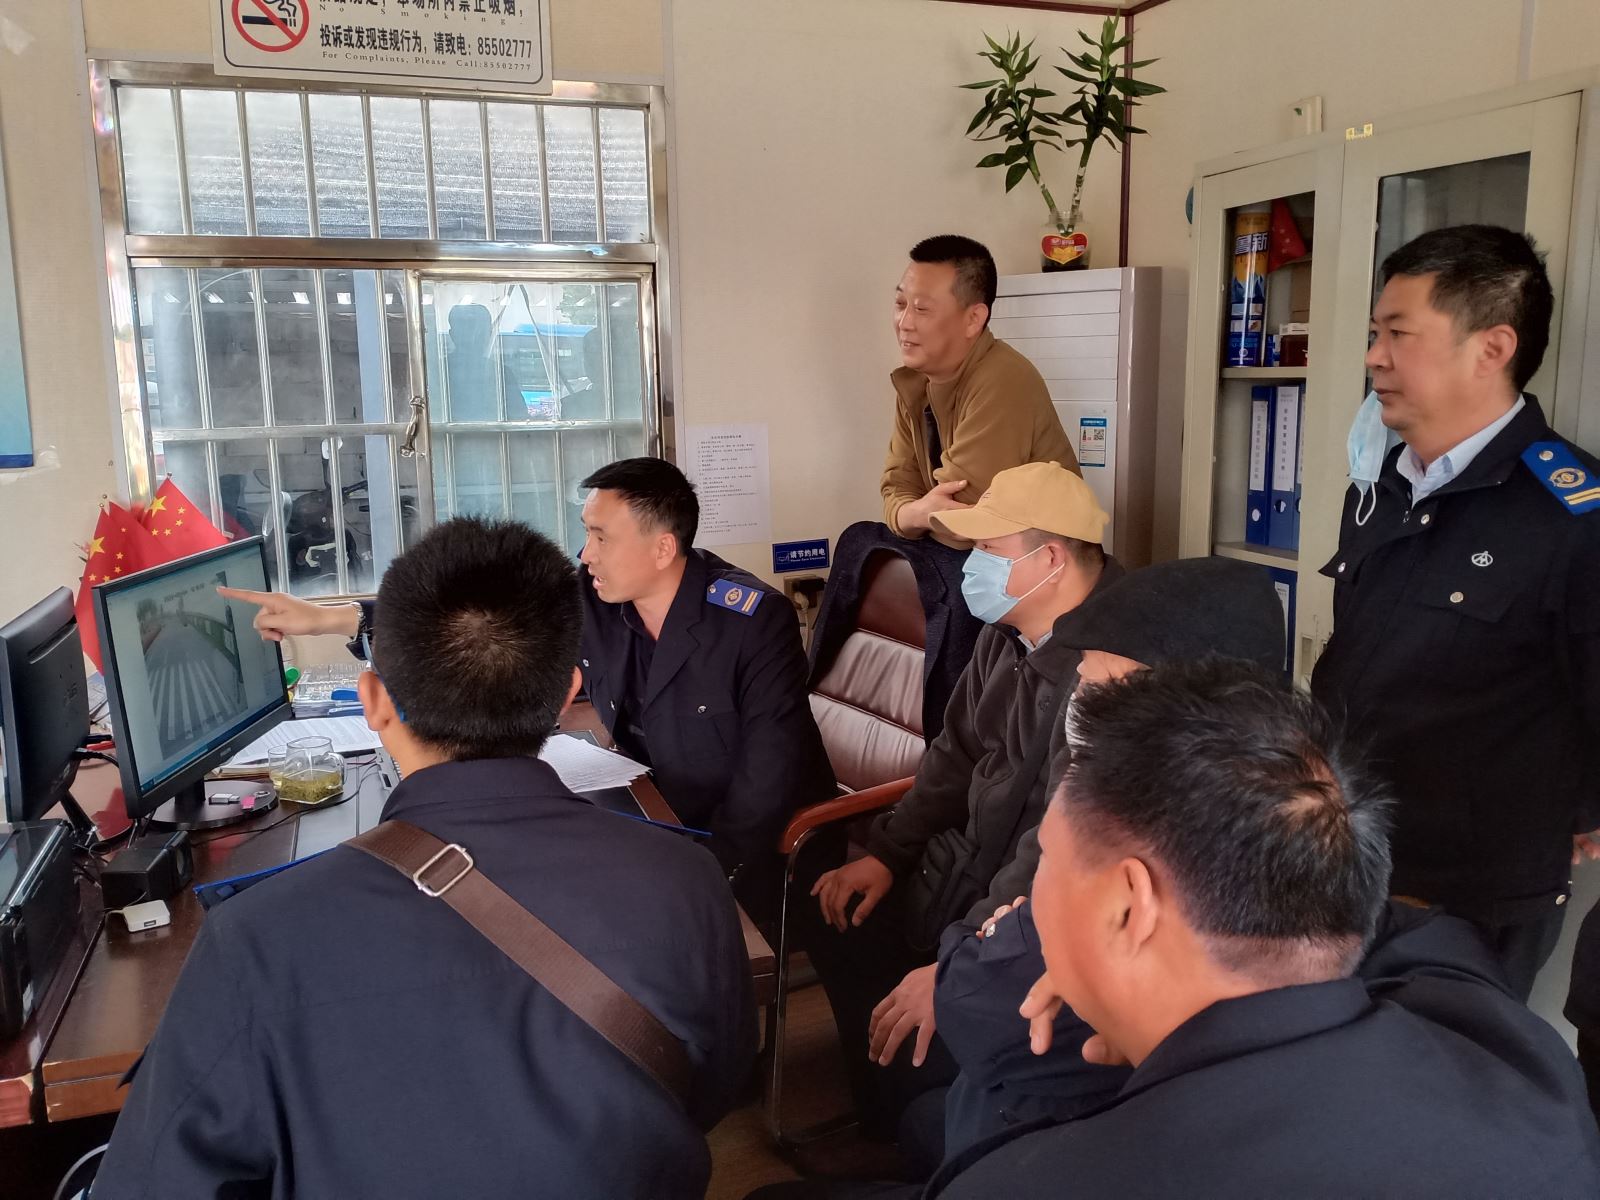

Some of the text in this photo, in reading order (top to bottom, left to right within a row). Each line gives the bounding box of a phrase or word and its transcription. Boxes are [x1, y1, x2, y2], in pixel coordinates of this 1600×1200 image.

[319, 4, 345, 13] No
[322, 51, 338, 59] For
[414, 56, 447, 65] Please
[456, 59, 531, 71] Call:85502777
[789, 547, 826, 559] 请节约用电
